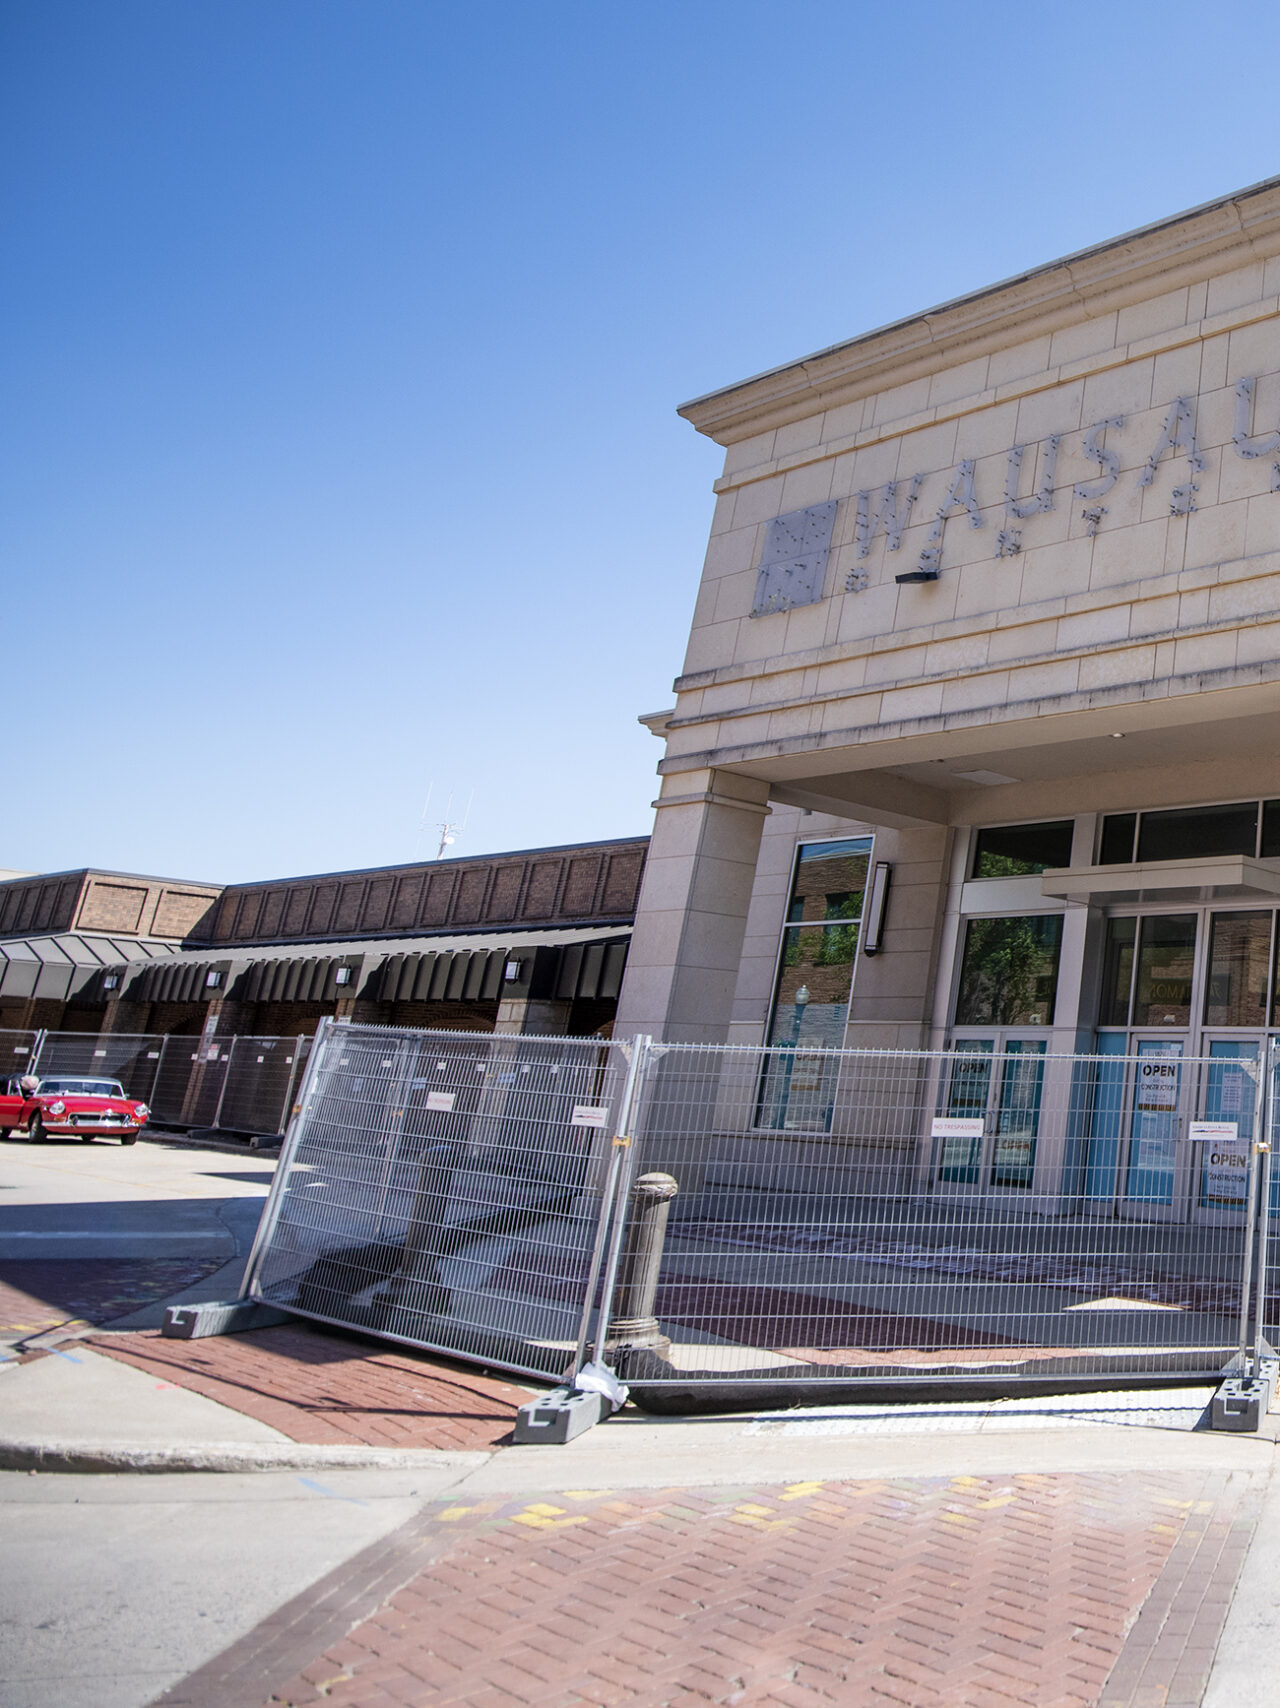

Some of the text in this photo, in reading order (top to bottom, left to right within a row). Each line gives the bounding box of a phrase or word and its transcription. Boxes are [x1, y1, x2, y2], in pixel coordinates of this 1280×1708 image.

[959, 1062, 988, 1074] OPEN
[1143, 1064, 1176, 1077] OPEN
[1210, 1153, 1246, 1168] OPEN
